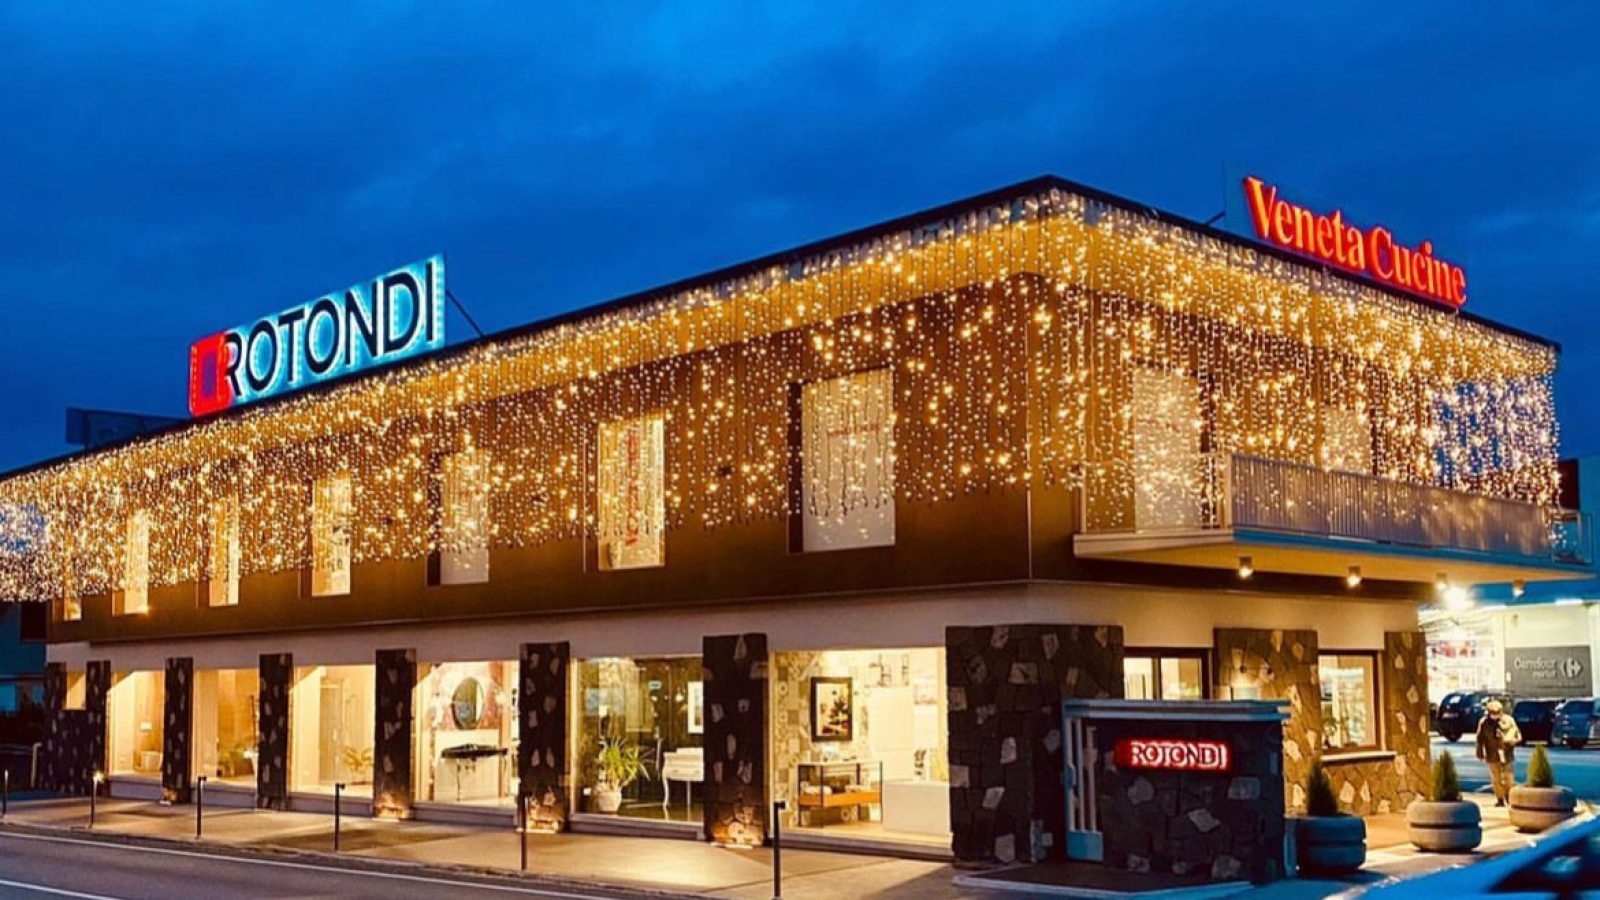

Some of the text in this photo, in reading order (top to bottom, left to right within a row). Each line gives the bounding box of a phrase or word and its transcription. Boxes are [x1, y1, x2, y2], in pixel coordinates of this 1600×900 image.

[1245, 175, 1467, 306] Veneta Cucine
[224, 261, 435, 398] ROTONDI
[1130, 740, 1228, 770] ROTONDI
